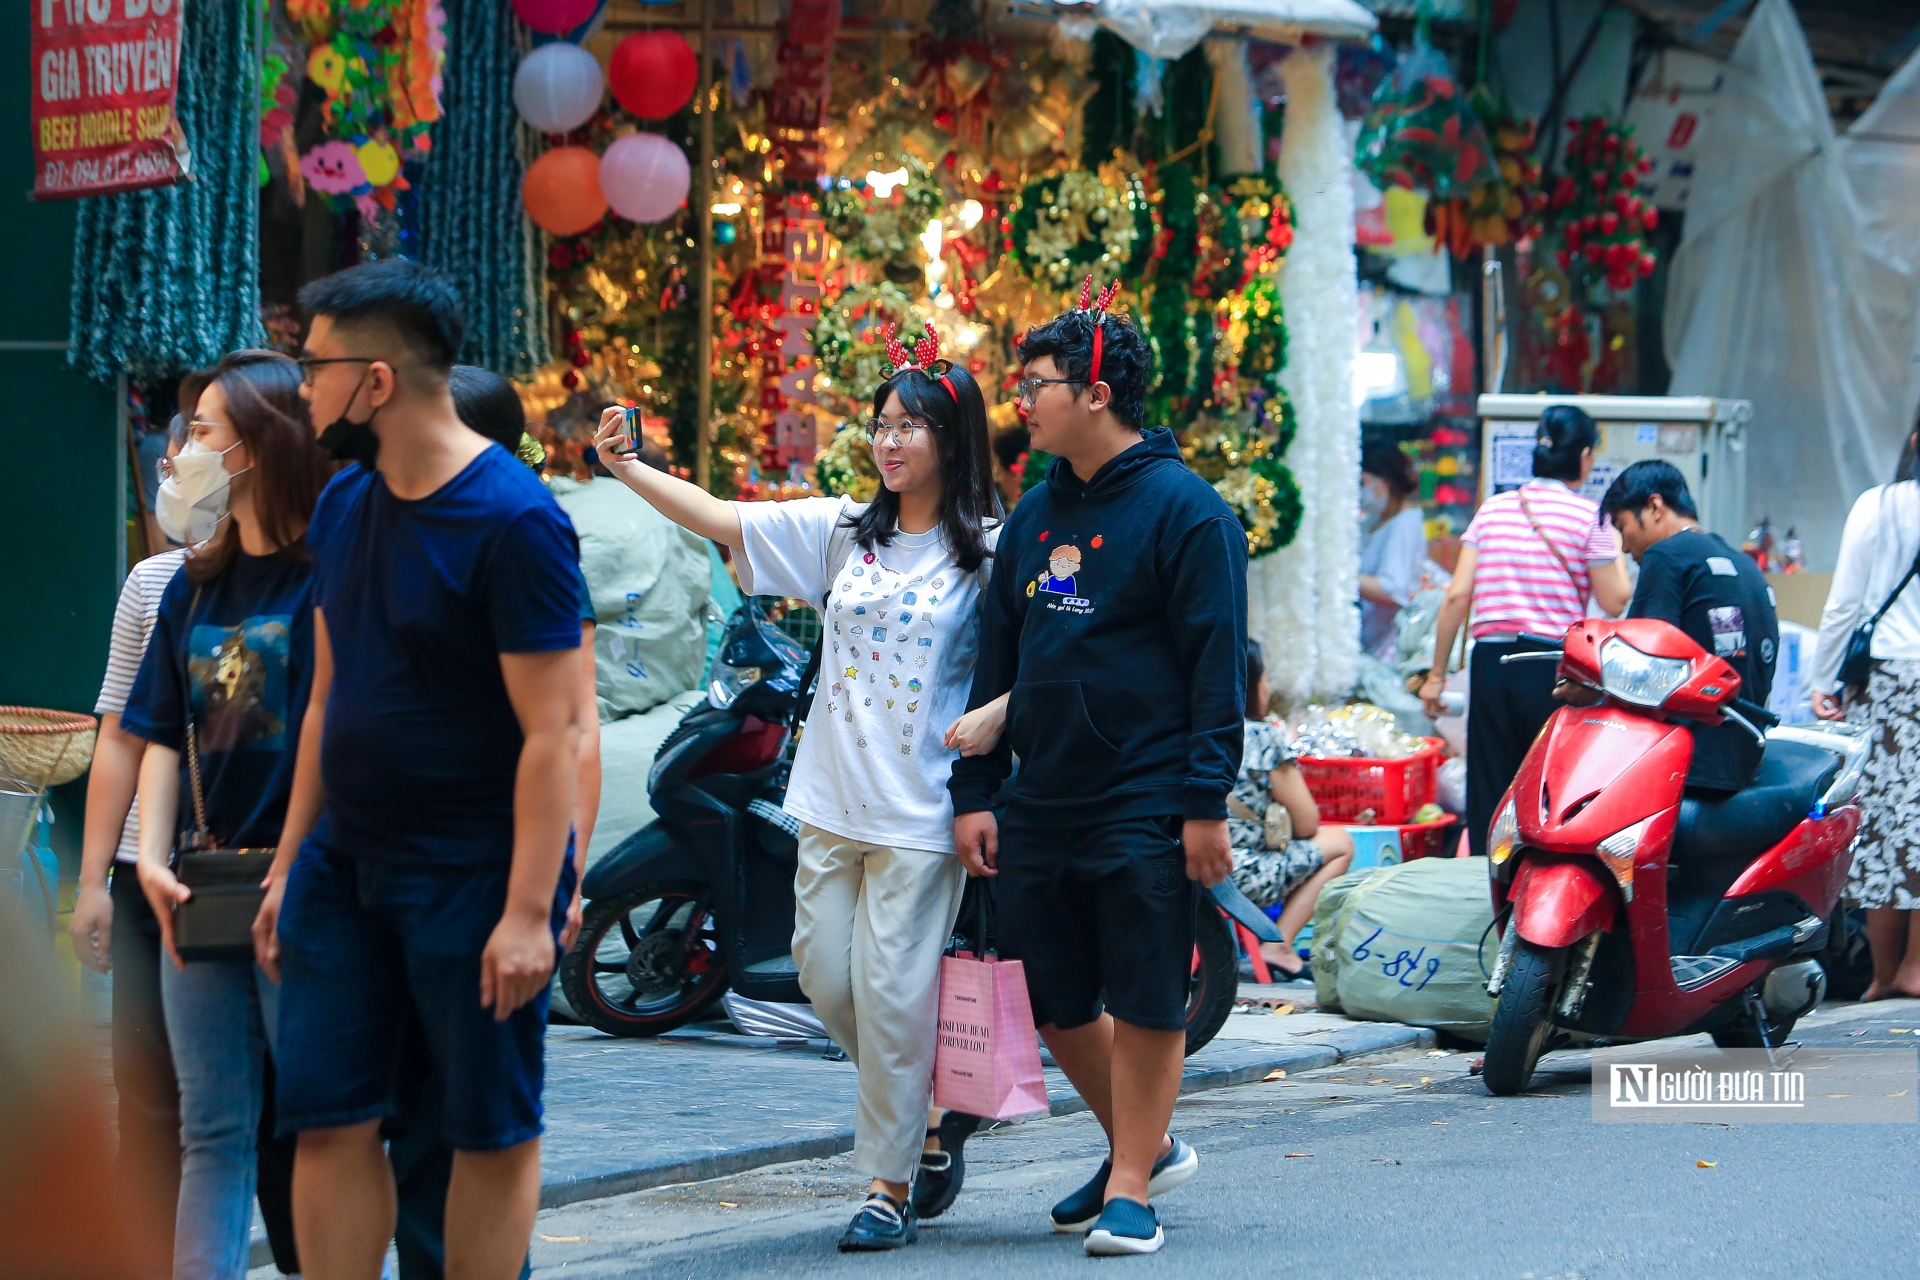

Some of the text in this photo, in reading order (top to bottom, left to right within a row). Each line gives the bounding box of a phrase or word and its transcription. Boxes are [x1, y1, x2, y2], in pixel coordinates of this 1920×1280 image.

[40, 48, 81, 102] GIA
[39, 115, 77, 151] BEEF
[80, 107, 133, 148] NOODLE
[939, 1034, 969, 1050] FOREVER
[956, 1022, 968, 1035] YOU
